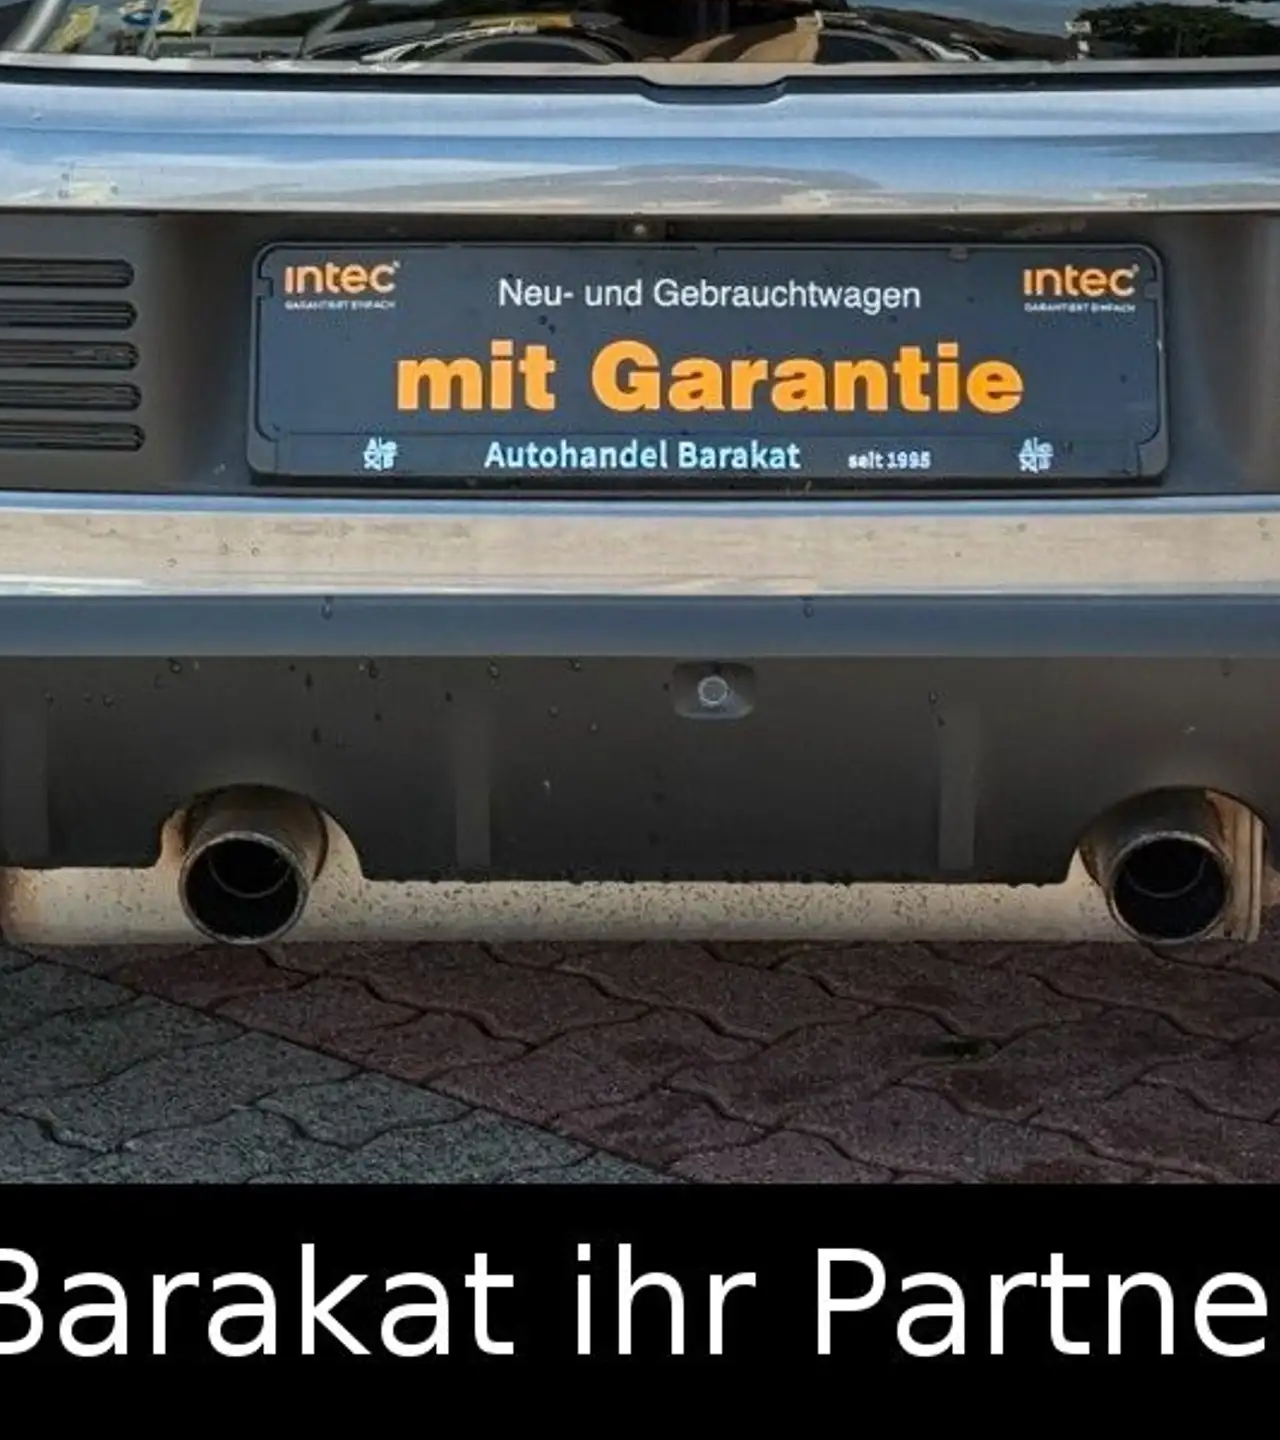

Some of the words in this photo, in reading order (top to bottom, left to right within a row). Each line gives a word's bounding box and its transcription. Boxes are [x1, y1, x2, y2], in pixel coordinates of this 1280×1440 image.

[284, 262, 397, 294] intec
[1023, 264, 1136, 297] intec
[498, 278, 574, 307] Neu-
[585, 278, 643, 307] und
[653, 278, 921, 315] Gebrauchtwagen
[397, 339, 557, 411] mit
[591, 340, 1024, 413] Garantie
[483, 440, 668, 470] Autohandel
[678, 440, 801, 470] Barakat
